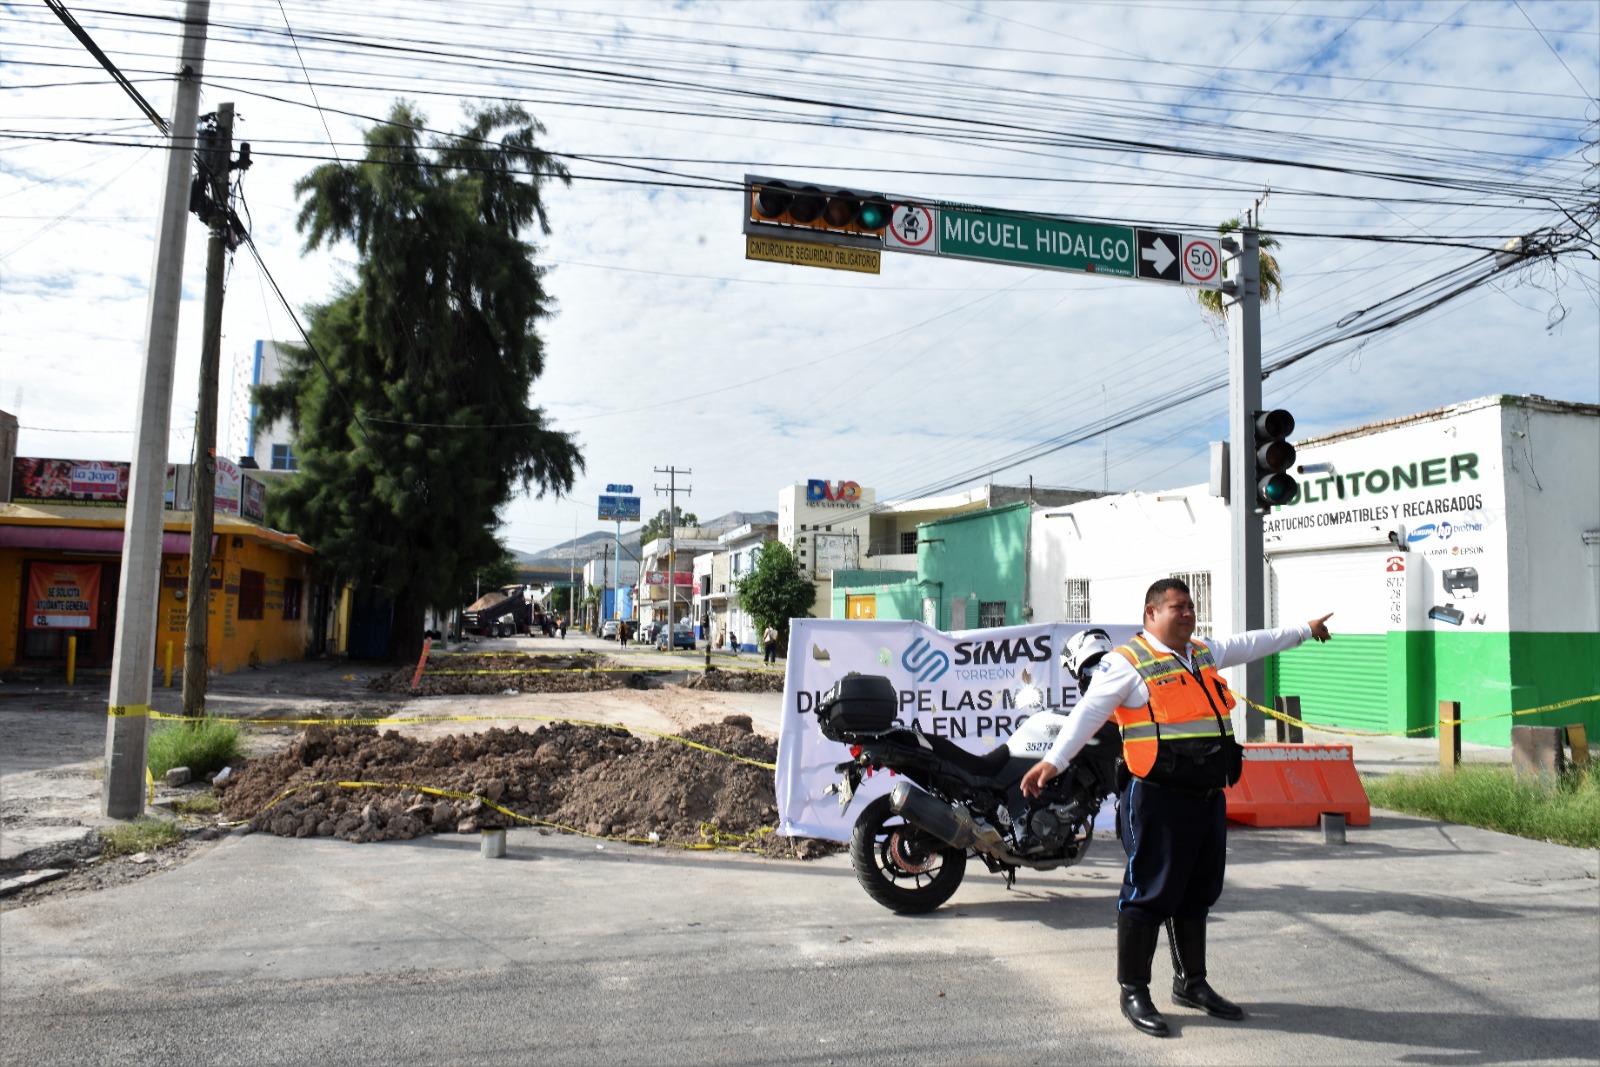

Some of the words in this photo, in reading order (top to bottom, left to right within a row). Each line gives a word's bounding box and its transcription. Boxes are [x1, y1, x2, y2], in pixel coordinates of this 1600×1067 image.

[945, 216, 1028, 249] MIGUEL
[1036, 228, 1130, 262] HIDALGO
[785, 245, 794, 257] DE
[796, 248, 832, 263] SEGURIDAD
[835, 251, 877, 268] OBLIGATORIO
[1191, 249, 1212, 267] 50
[807, 479, 862, 502] DUO
[1263, 515, 1315, 533] CARTUCHOS
[1317, 506, 1389, 527] COMPATIBLES
[1391, 504, 1399, 519] Y
[1403, 493, 1483, 518] RECARGADOS
[1453, 523, 1483, 533] brother
[1460, 546, 1484, 555] EPSON
[1386, 577, 1404, 588] 8712
[48, 587, 56, 598] SE
[57, 587, 80, 599] SOLICITA
[37, 600, 65, 611] AYUDANTE
[65, 601, 89, 611] GENERAL
[942, 690, 993, 711] LAS
[933, 717, 968, 739] EN
